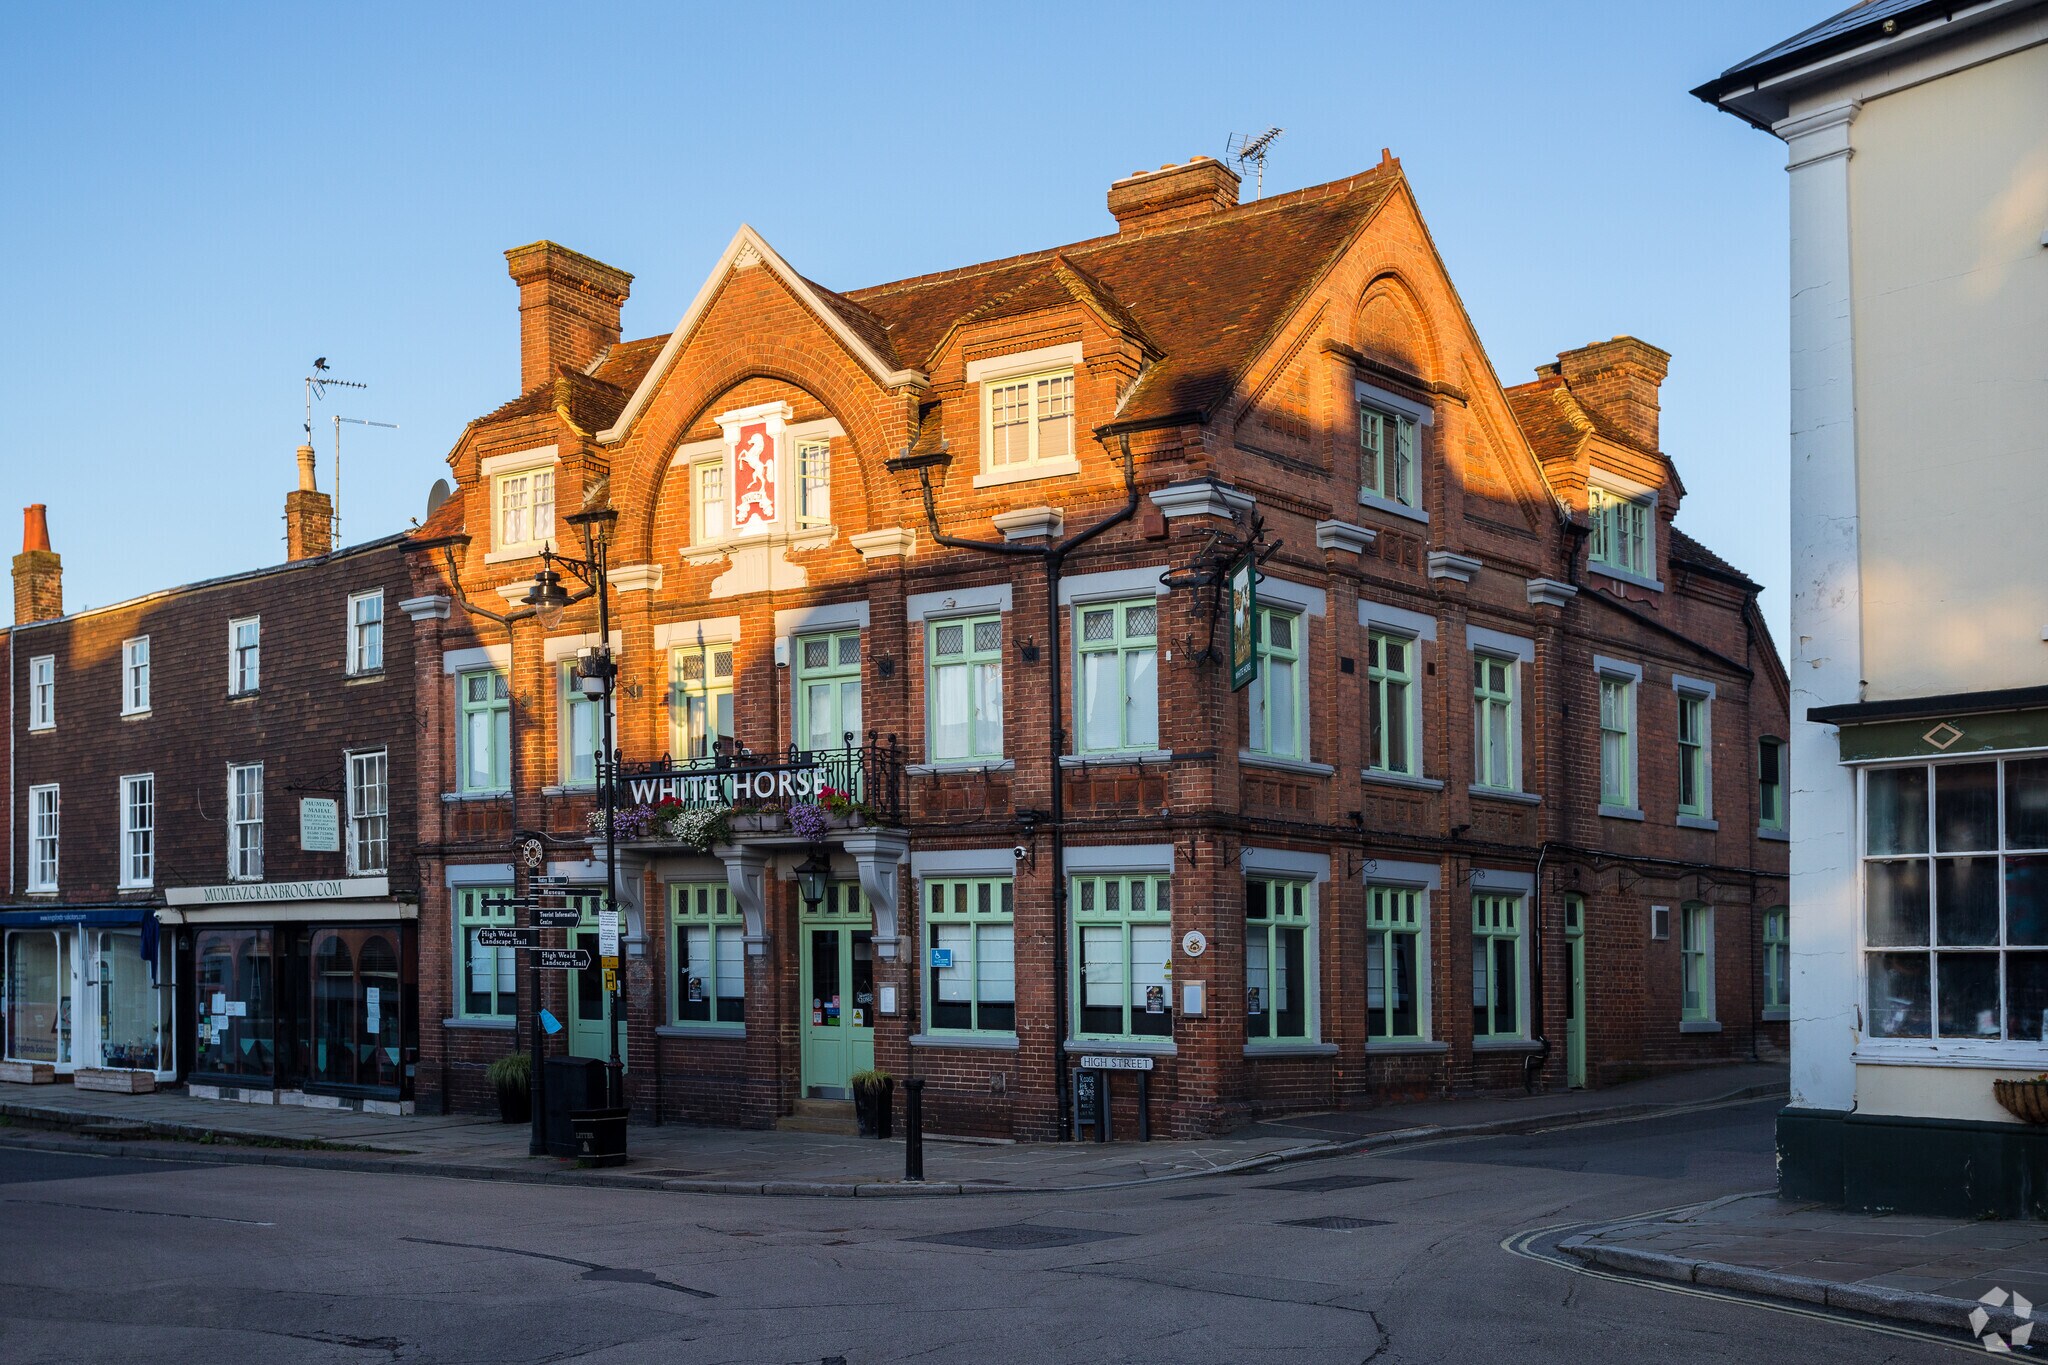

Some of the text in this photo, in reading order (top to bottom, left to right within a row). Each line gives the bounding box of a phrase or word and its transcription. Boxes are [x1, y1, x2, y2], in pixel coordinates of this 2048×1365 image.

[629, 768, 826, 804] WHITE HORSE
[203, 882, 343, 902] MUMTAZCRANBROOK.COM
[481, 930, 517, 939] High Weald
[481, 938, 511, 946] Landscape
[541, 951, 557, 960] High
[541, 959, 571, 968] Landscape
[1083, 1057, 1150, 1068] HIGH STREET
